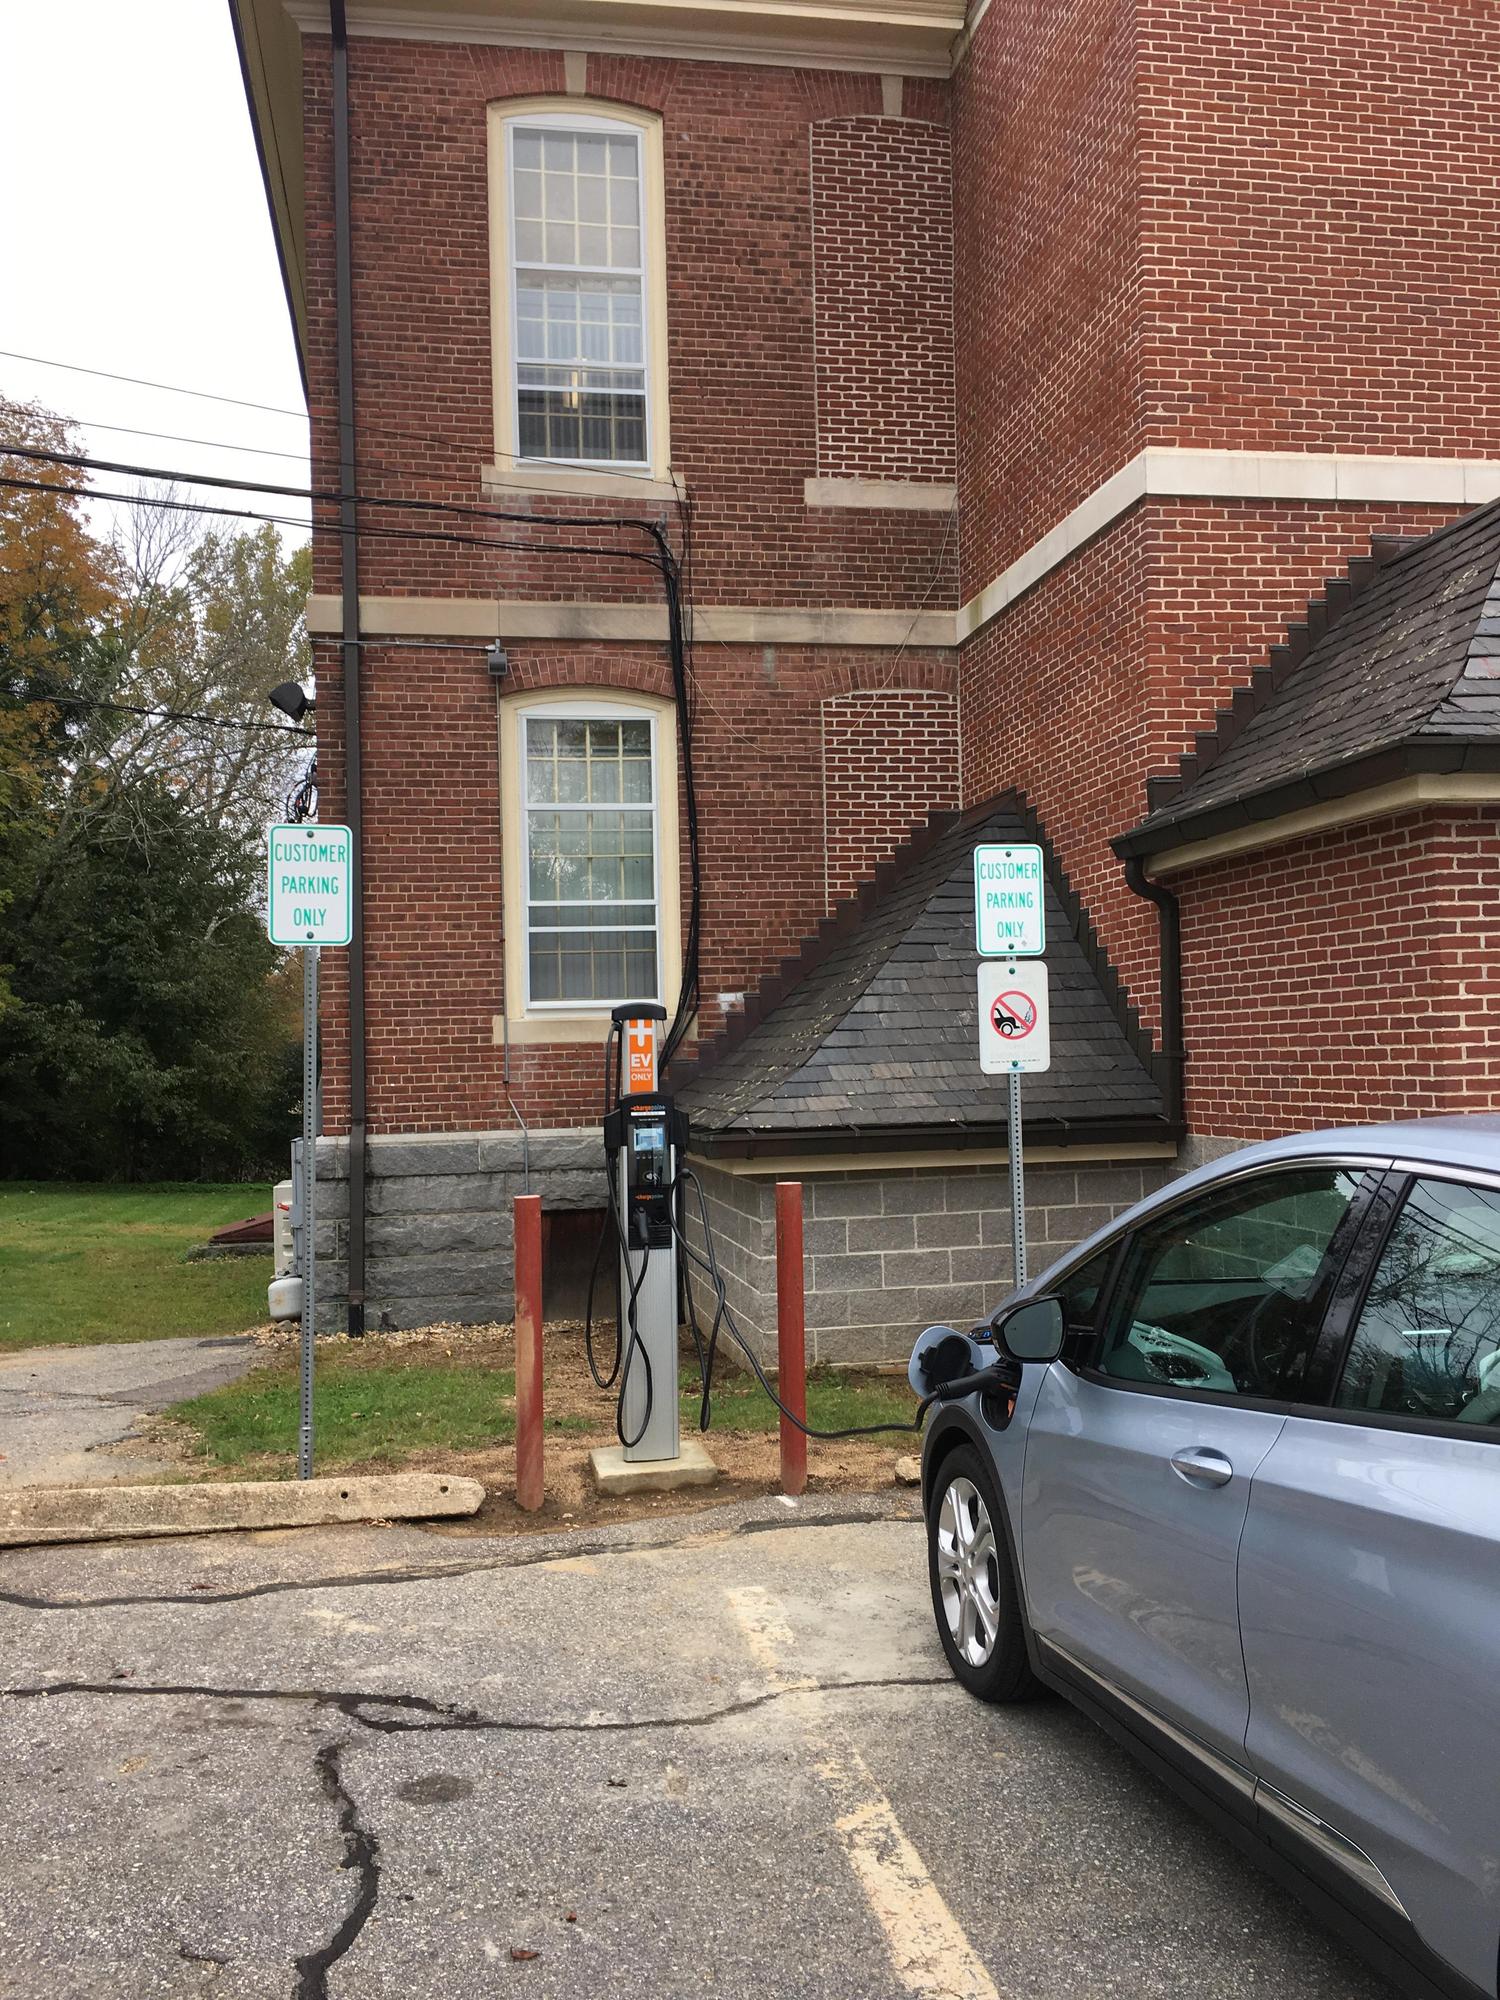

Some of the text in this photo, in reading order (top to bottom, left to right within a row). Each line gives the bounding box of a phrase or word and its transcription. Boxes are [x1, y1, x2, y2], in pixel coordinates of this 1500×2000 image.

[275, 843, 346, 862] CUSTOMER
[980, 862, 1038, 880] CUSTOMER
[281, 875, 339, 894] PARKING
[986, 892, 1034, 909] PARKING
[293, 908, 327, 926] ONLY
[997, 921, 1025, 938] ONLY
[631, 1053, 652, 1067] EV
[630, 1073, 652, 1081] ONLY
